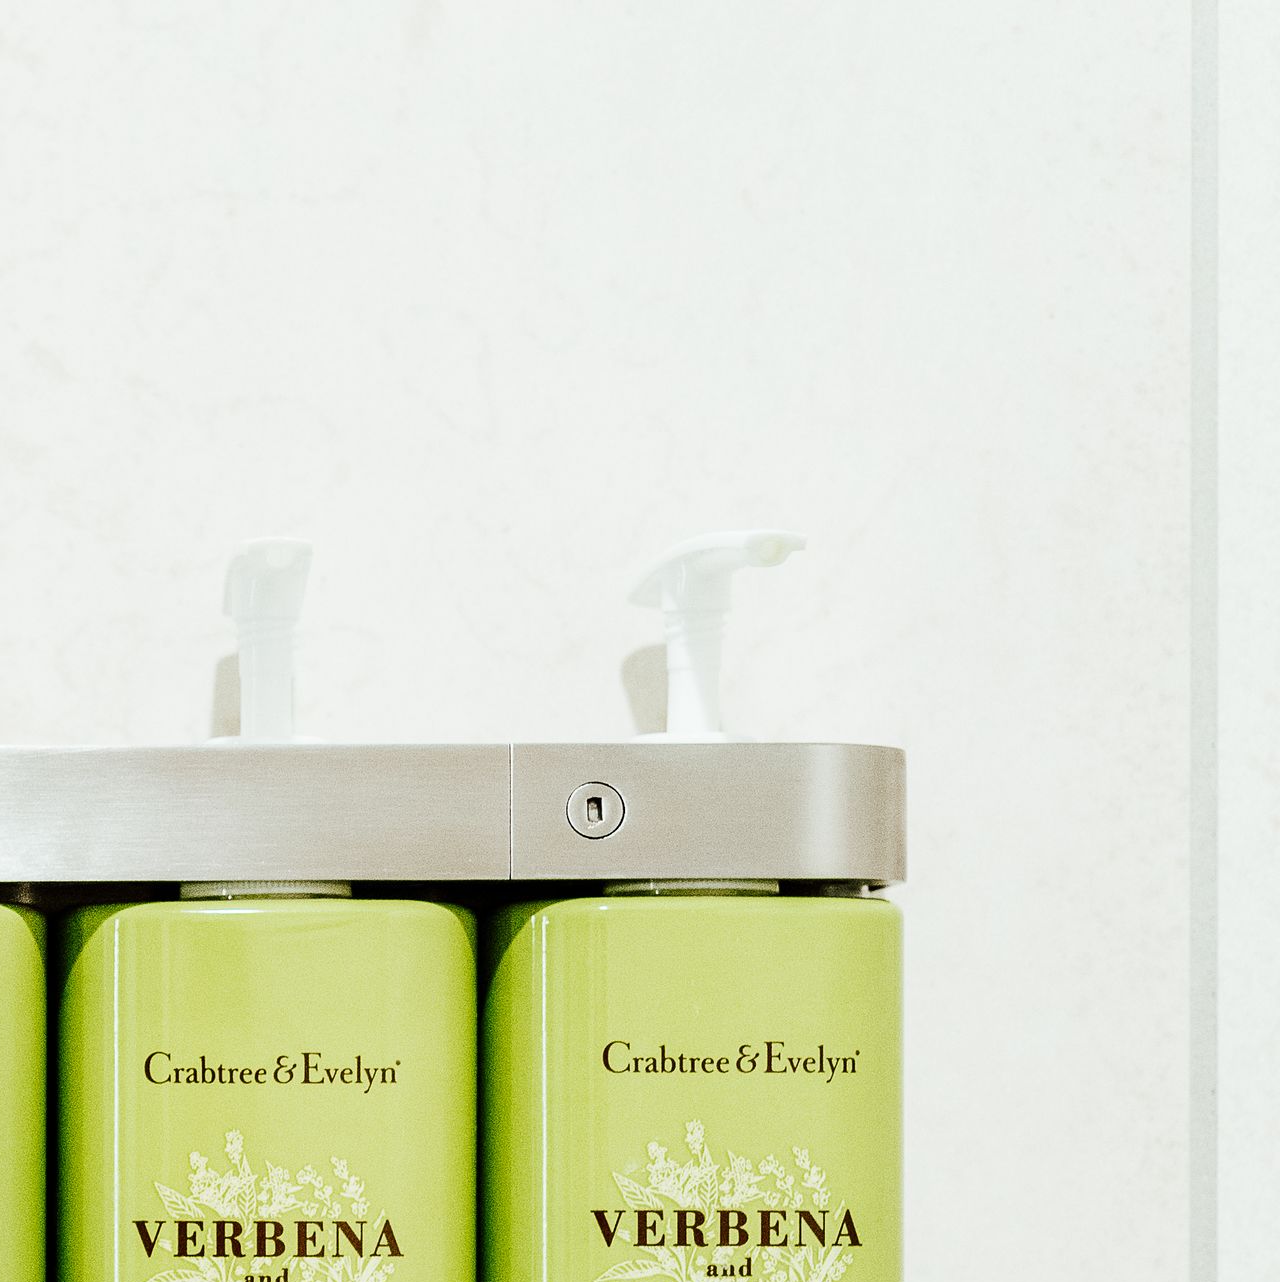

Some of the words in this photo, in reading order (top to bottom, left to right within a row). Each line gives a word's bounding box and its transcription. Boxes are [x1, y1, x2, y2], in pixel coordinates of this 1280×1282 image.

[144, 1051, 267, 1085] Crabtree
[273, 1055, 297, 1084] &
[602, 1040, 730, 1074] Crabtree
[735, 1044, 760, 1074] &
[132, 1219, 405, 1259] VERBENA
[590, 1208, 863, 1248] VERBENA
[706, 1256, 753, 1278] and
